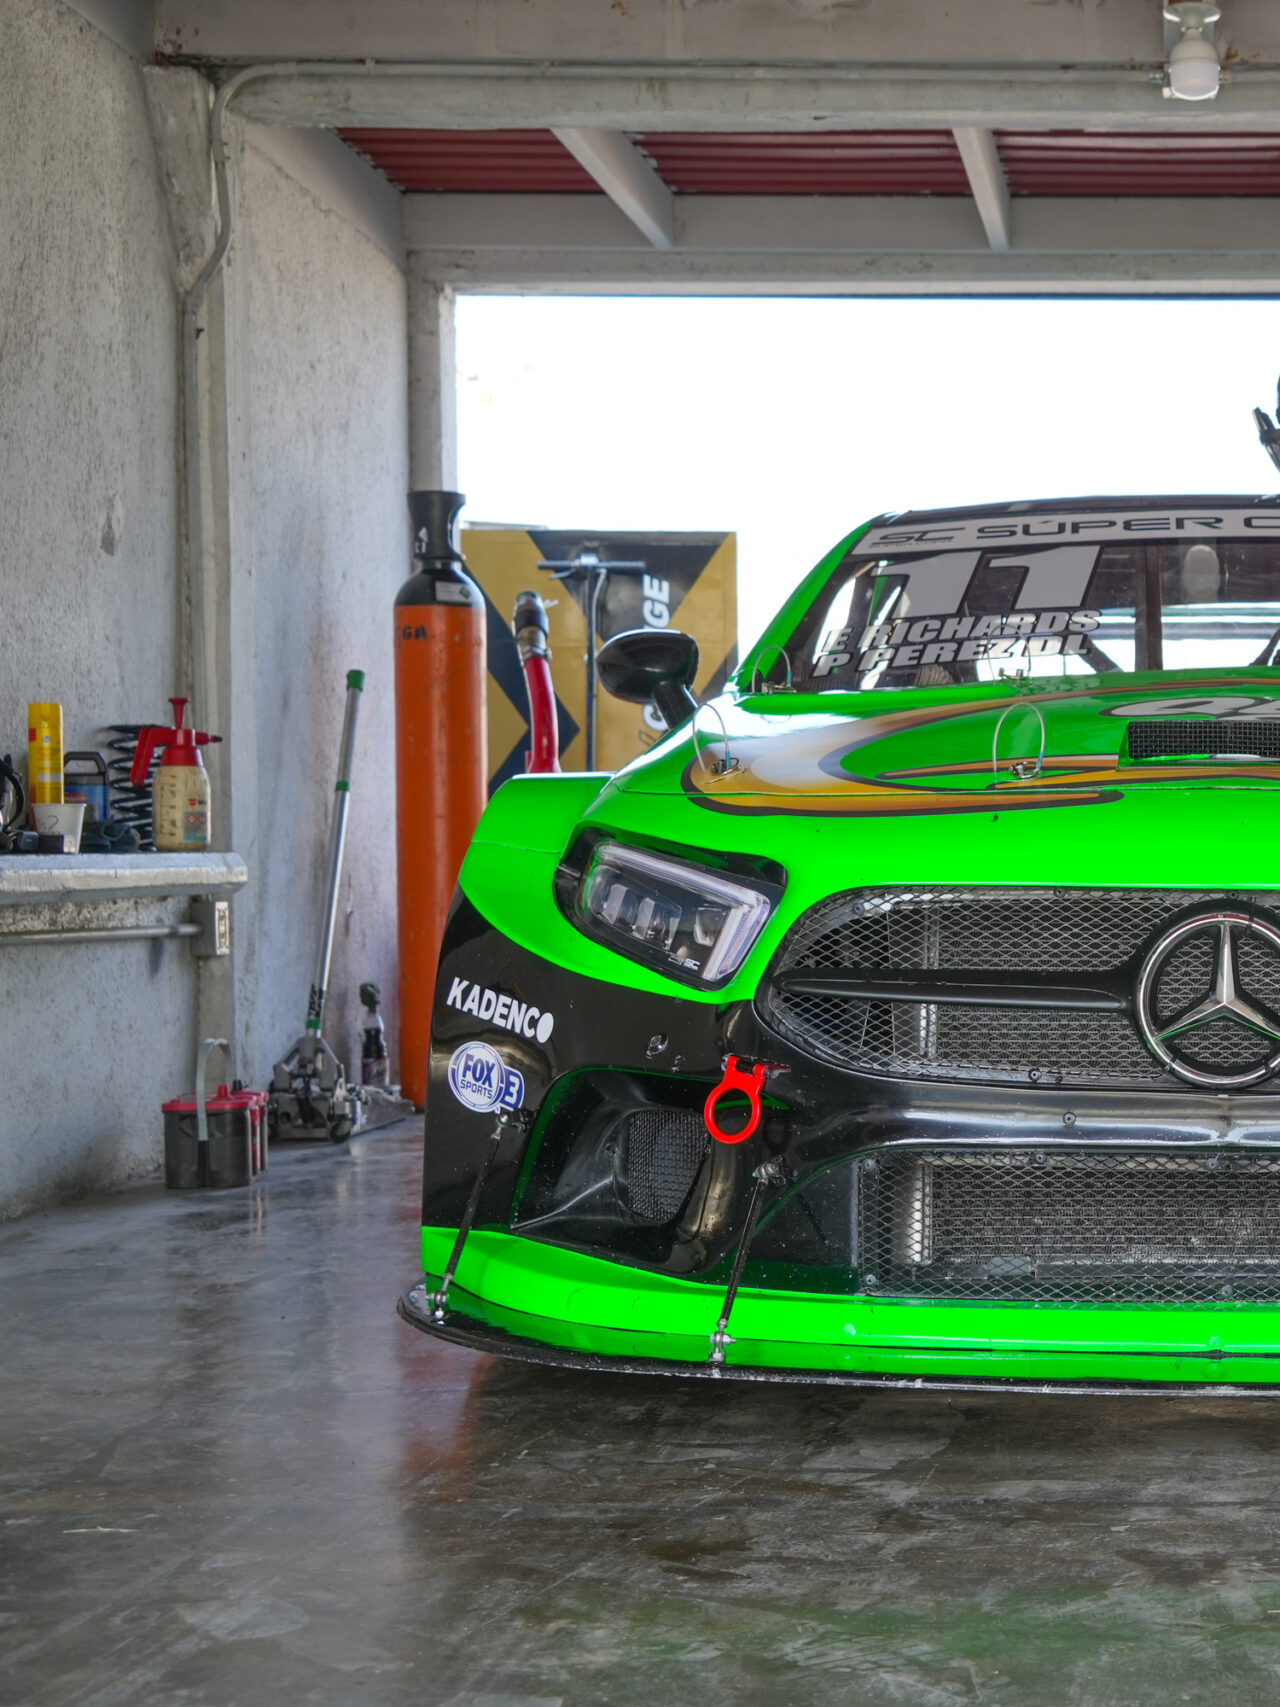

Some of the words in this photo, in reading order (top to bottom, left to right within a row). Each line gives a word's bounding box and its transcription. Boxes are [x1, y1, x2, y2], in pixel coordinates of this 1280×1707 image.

[869, 544, 1101, 619] 11
[821, 627, 853, 653] E
[857, 609, 1101, 650] RICHARDS
[811, 652, 851, 678] P
[446, 976, 555, 1044] KADENCO
[460, 1078, 493, 1100] SPORTS
[461, 1053, 496, 1089] FOX
[504, 1073, 520, 1105] 3
